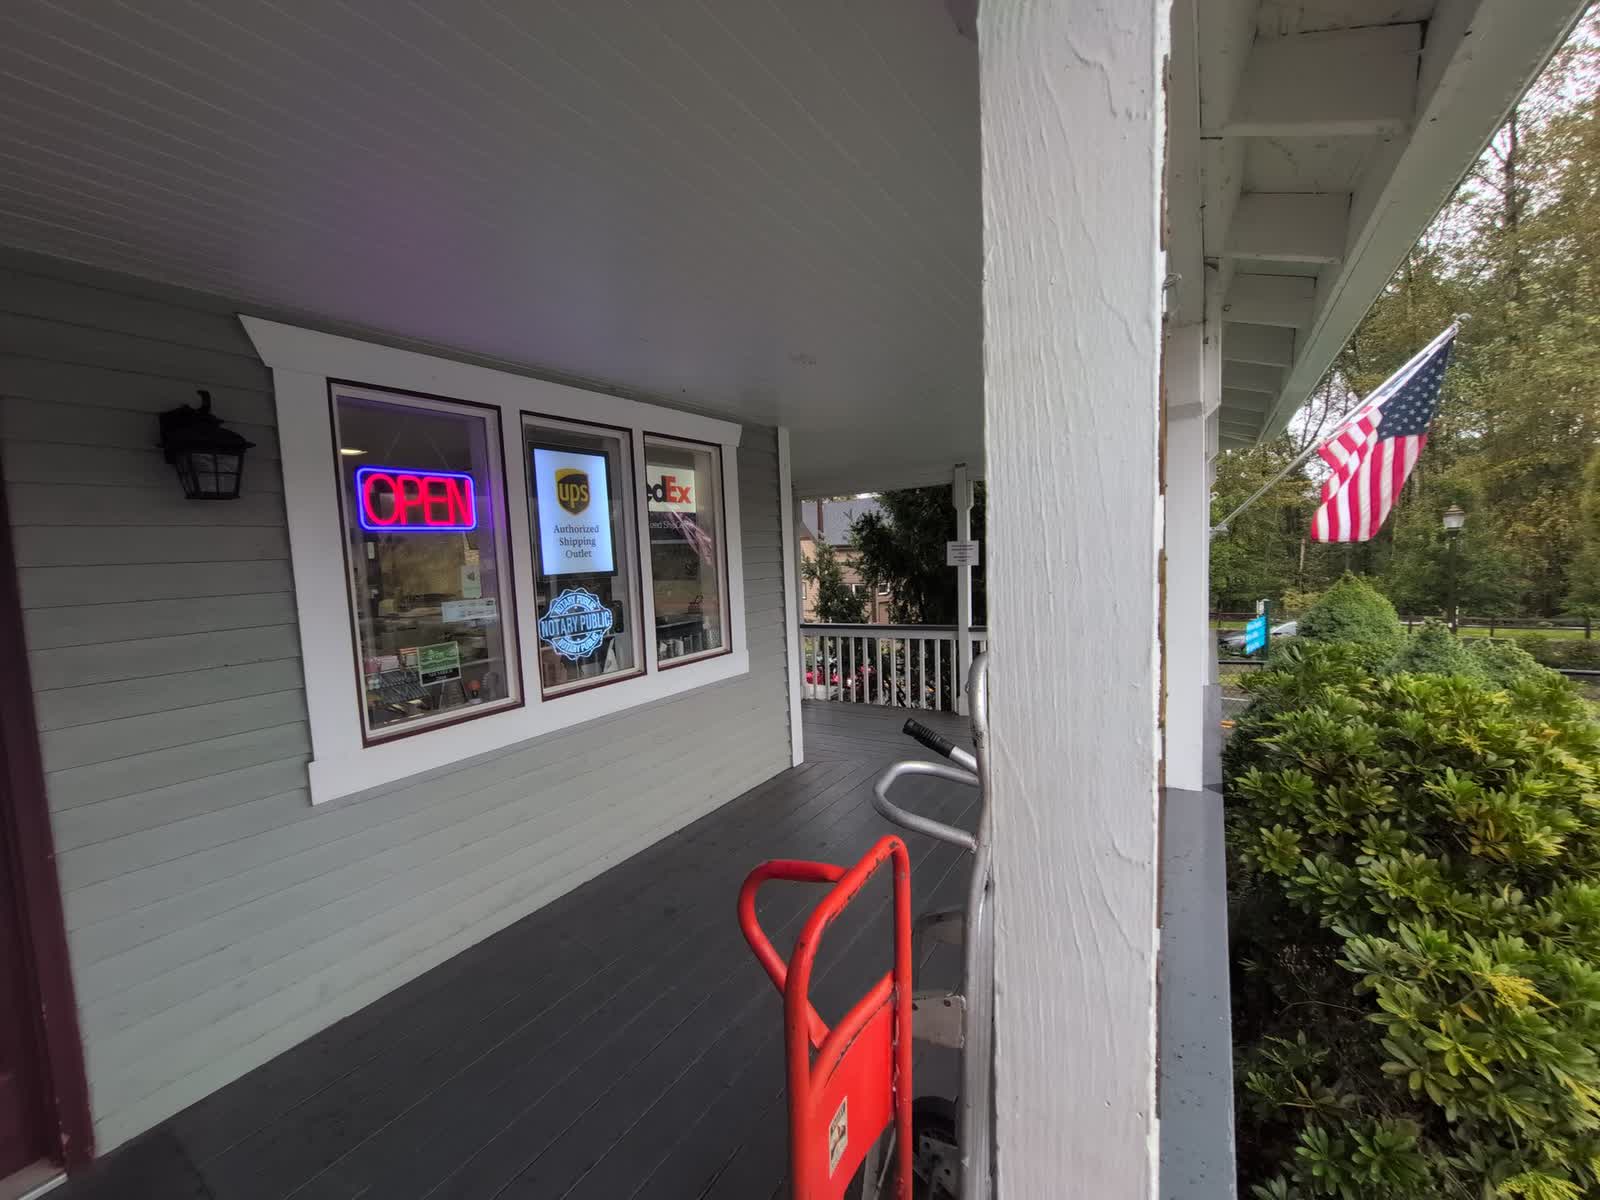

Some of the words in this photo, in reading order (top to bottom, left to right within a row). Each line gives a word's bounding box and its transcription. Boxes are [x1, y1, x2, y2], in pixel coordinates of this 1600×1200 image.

[364, 473, 473, 526] OPEN
[554, 524, 600, 534] Authorized
[559, 537, 597, 547] Shipping
[565, 549, 592, 559] Outlet
[541, 616, 578, 637] NOTARY
[580, 611, 610, 631] PUBLIC
